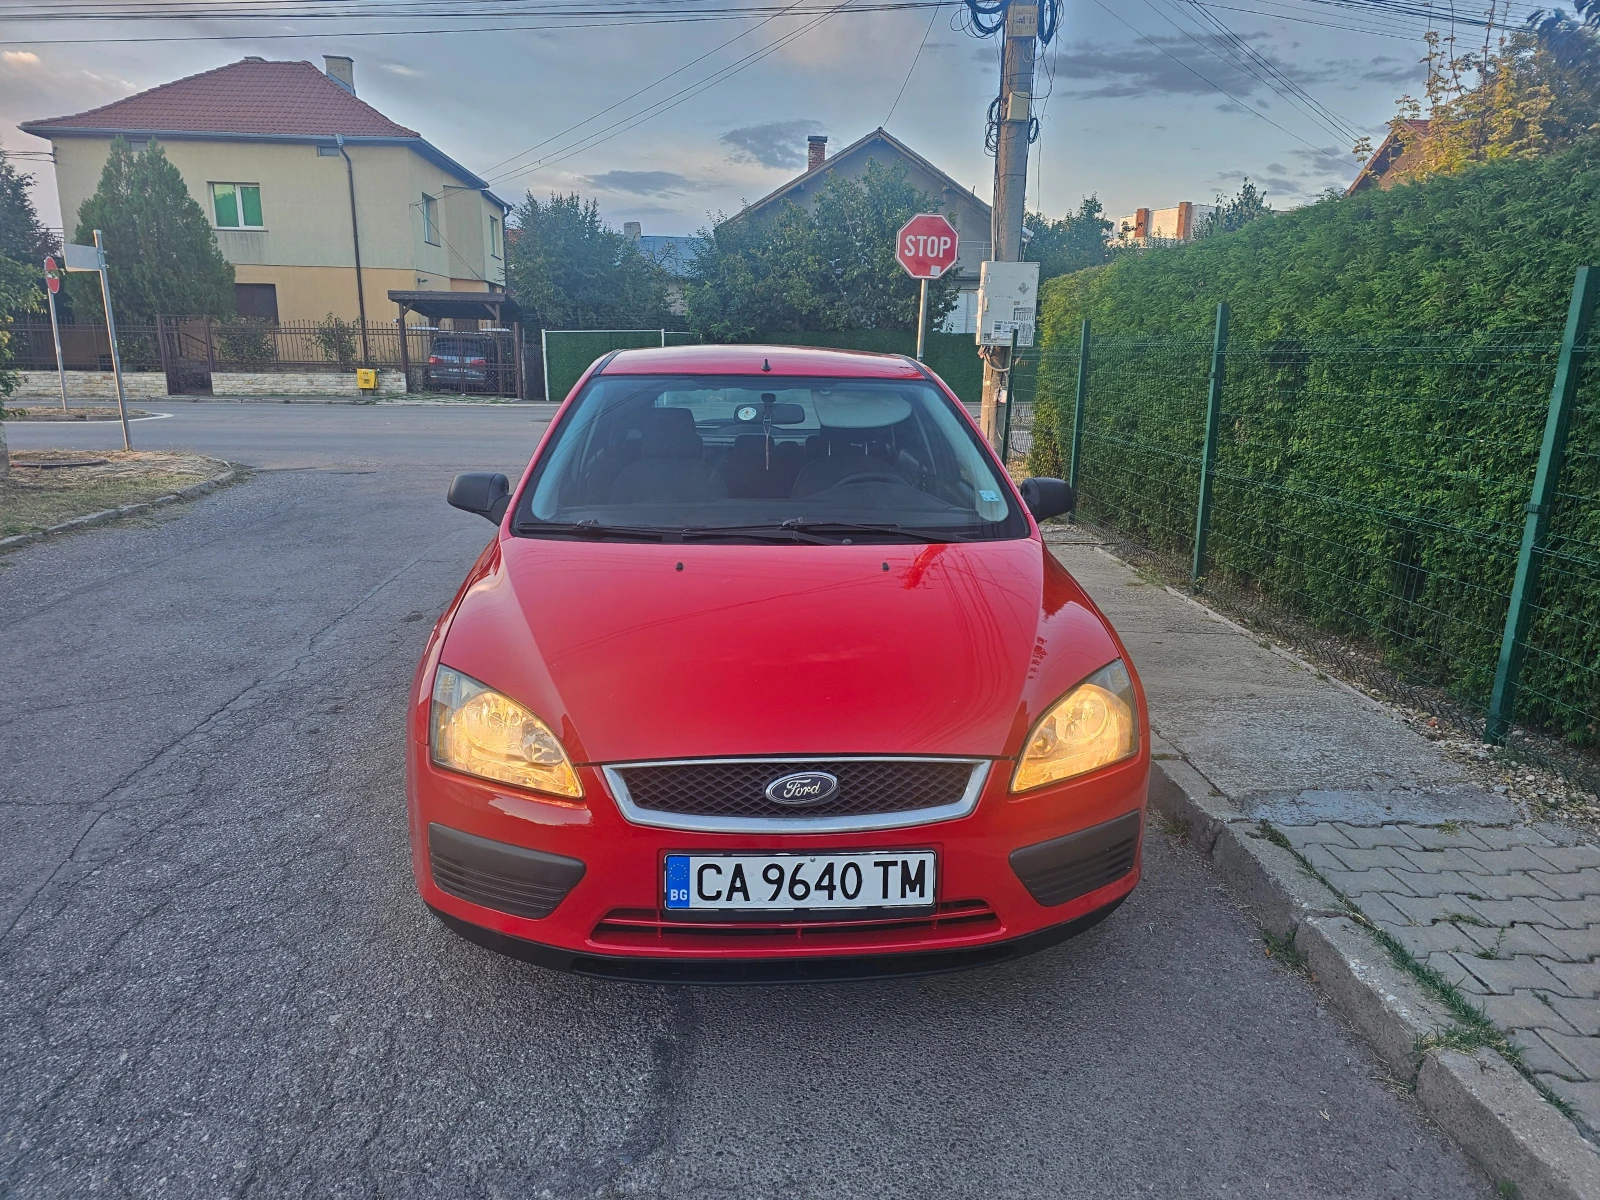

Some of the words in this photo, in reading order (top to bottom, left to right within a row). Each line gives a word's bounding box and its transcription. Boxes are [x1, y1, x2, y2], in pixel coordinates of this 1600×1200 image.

[904, 235, 951, 258] STOP
[783, 778, 821, 798] Ford
[697, 863, 751, 902] CA
[762, 861, 863, 902] 9640
[873, 859, 926, 899] TM
[670, 889, 688, 901] BG
